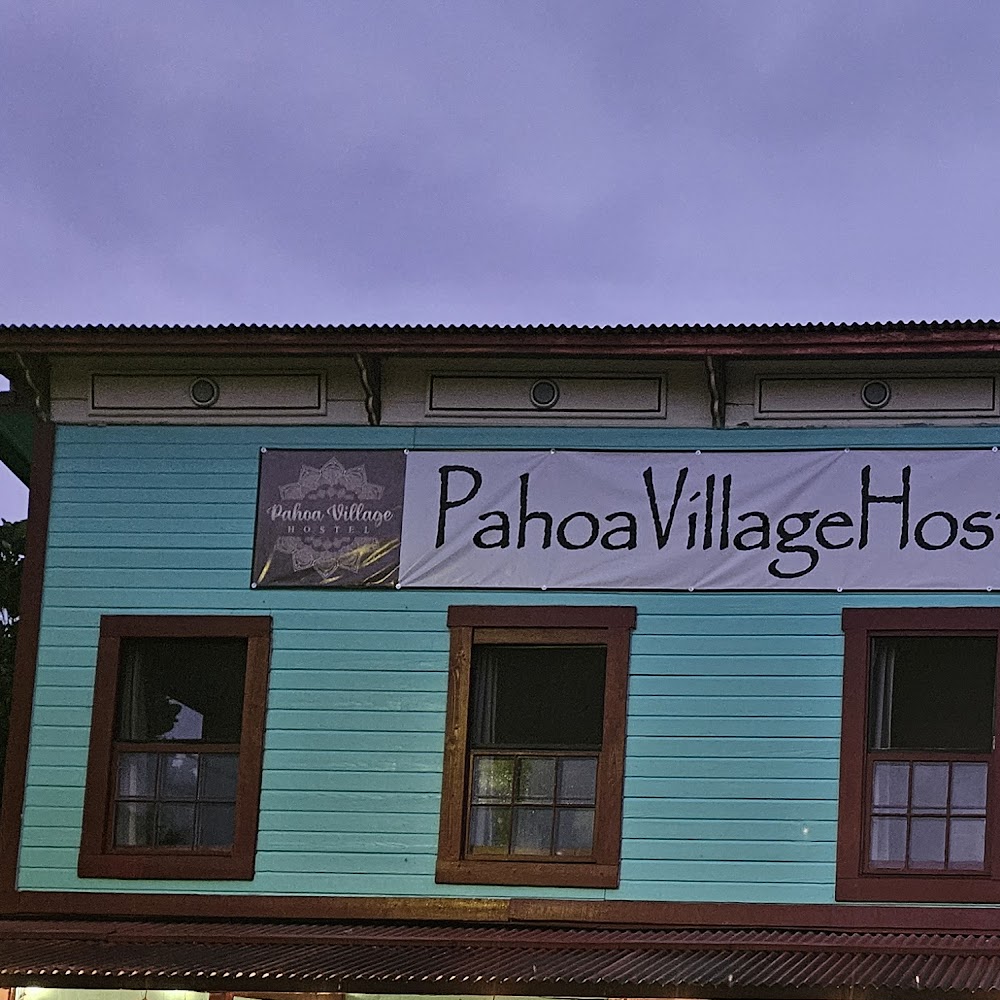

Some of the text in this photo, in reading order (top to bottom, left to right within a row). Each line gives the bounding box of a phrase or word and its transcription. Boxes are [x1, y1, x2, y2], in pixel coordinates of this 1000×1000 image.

[266, 503, 394, 528] Pahoa Village
[287, 525, 370, 534] HOSTEL
